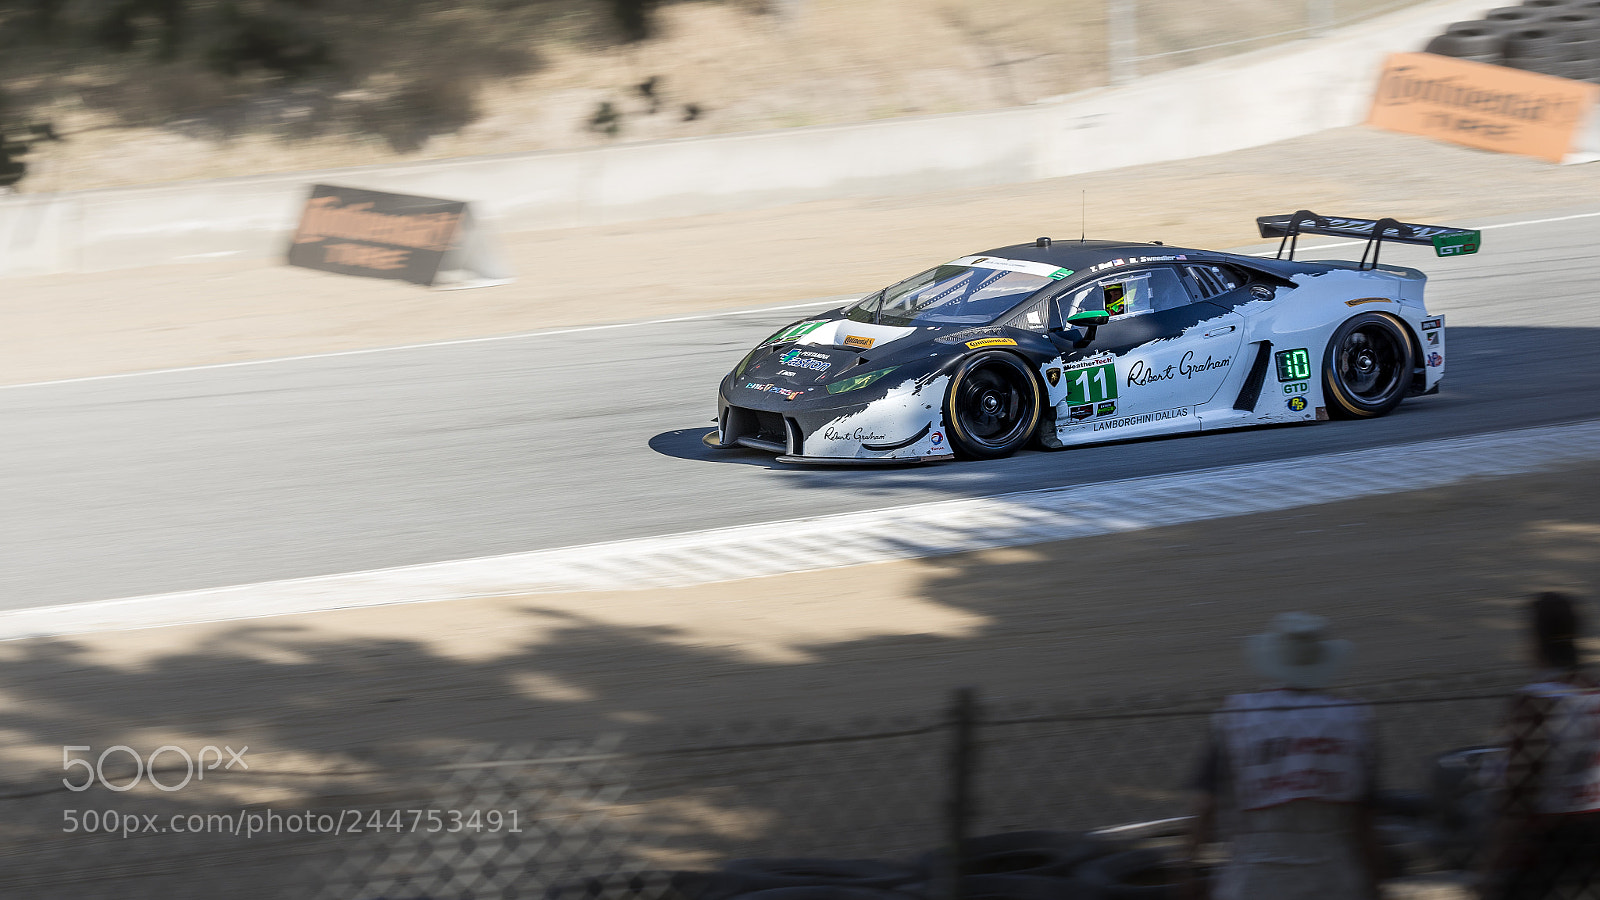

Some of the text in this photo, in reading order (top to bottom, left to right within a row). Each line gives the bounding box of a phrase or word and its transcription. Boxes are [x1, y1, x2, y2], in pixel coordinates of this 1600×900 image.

[1440, 243, 1476, 255] GTD
[1063, 356, 1113, 369] WeatherTech
[1127, 350, 1231, 388] Robert Graham
[1286, 350, 1310, 378] 10
[1075, 367, 1108, 402] 11
[1283, 382, 1308, 394] GTD
[1093, 408, 1188, 432] LAMBORGHINI DALLAS
